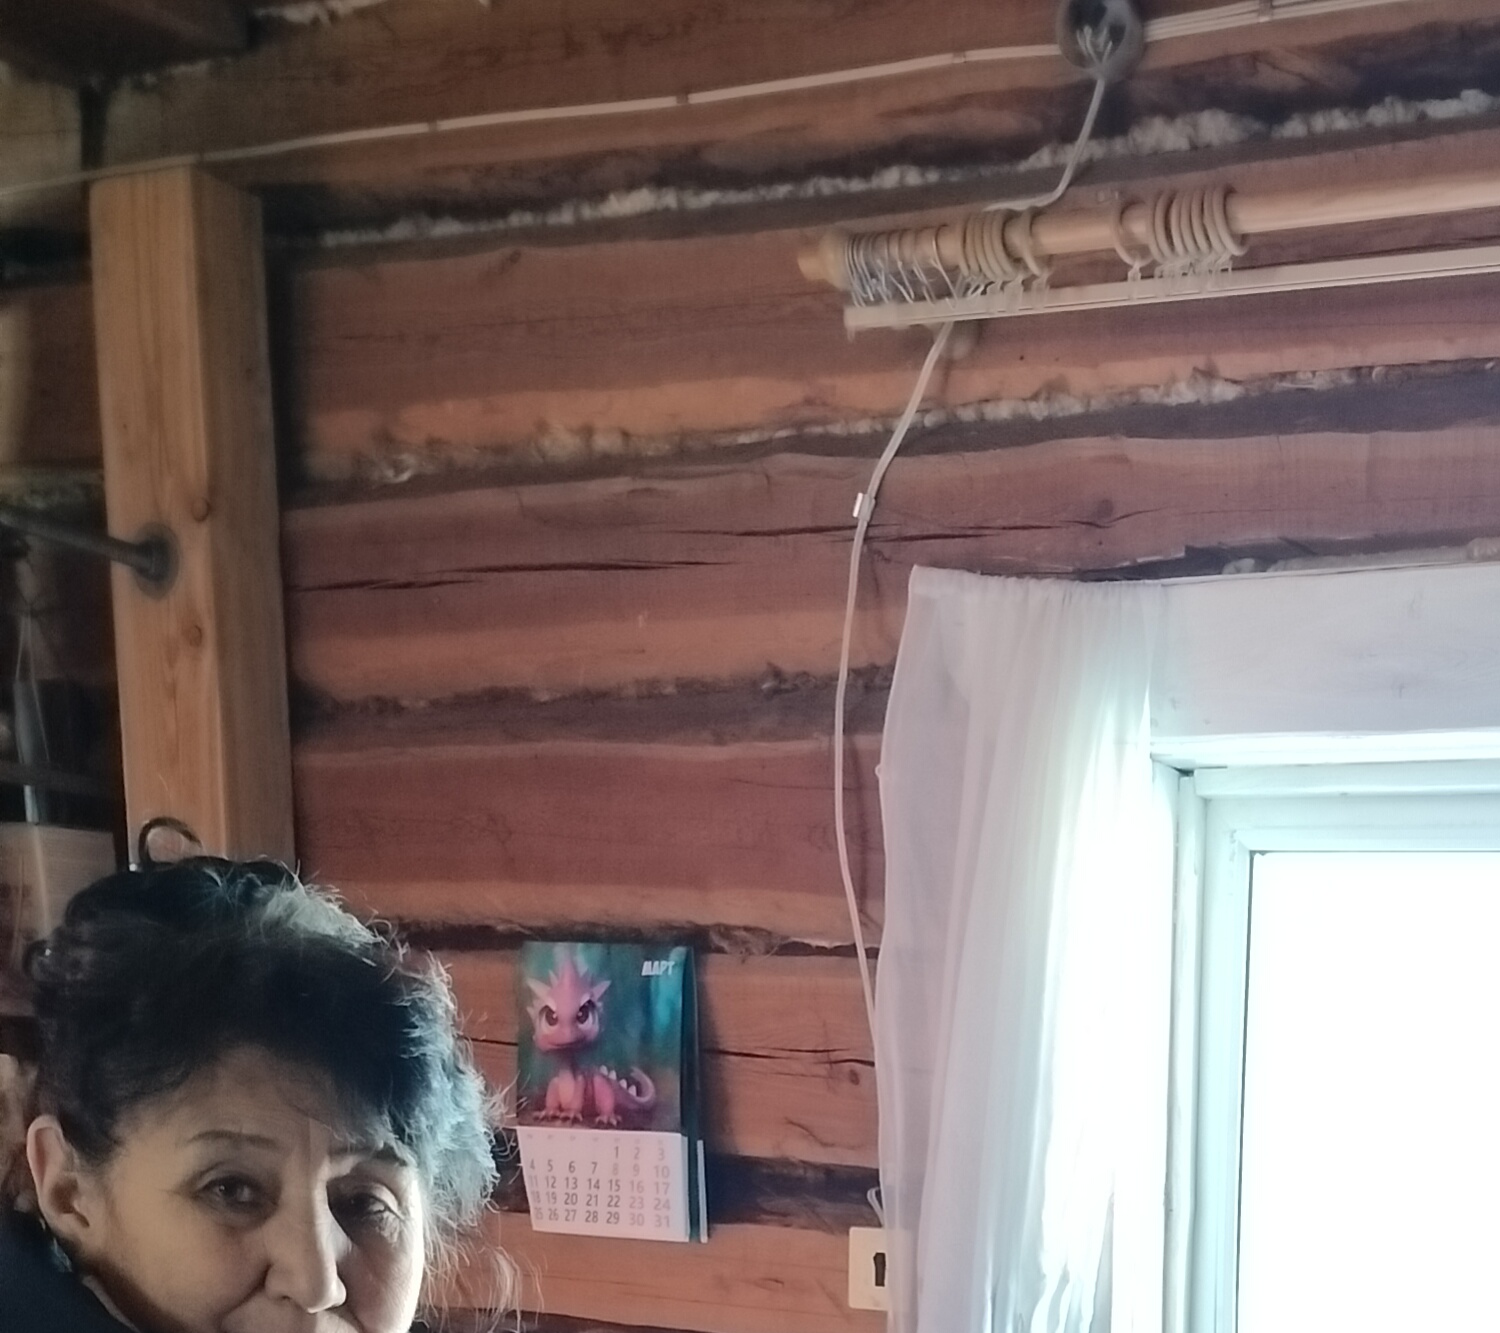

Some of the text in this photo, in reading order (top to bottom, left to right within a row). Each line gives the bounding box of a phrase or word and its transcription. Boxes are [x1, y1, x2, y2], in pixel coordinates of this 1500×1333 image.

[641, 960, 675, 976] МАРТ
[614, 1146, 665, 1161] 1 2 3
[530, 1158, 670, 1178] 4 5 6 7 8 9 10
[545, 1176, 556, 1189] 12
[565, 1177, 578, 1190] 13
[588, 1178, 600, 1190] 14
[608, 1179, 620, 1192] 15
[630, 1180, 644, 1194] 16
[654, 1181, 670, 1195] 17
[546, 1191, 557, 1204] 19
[564, 1192, 578, 1205] 20
[586, 1193, 598, 1207] 21
[607, 1195, 620, 1208] 22
[629, 1196, 644, 1209] 23
[654, 1197, 671, 1211] 24
[548, 1208, 559, 1221] 26
[564, 1209, 577, 1222] 27
[585, 1210, 598, 1223] 28
[606, 1211, 620, 1225] 29
[629, 1212, 645, 1226] 30
[655, 1214, 670, 1228] 31
